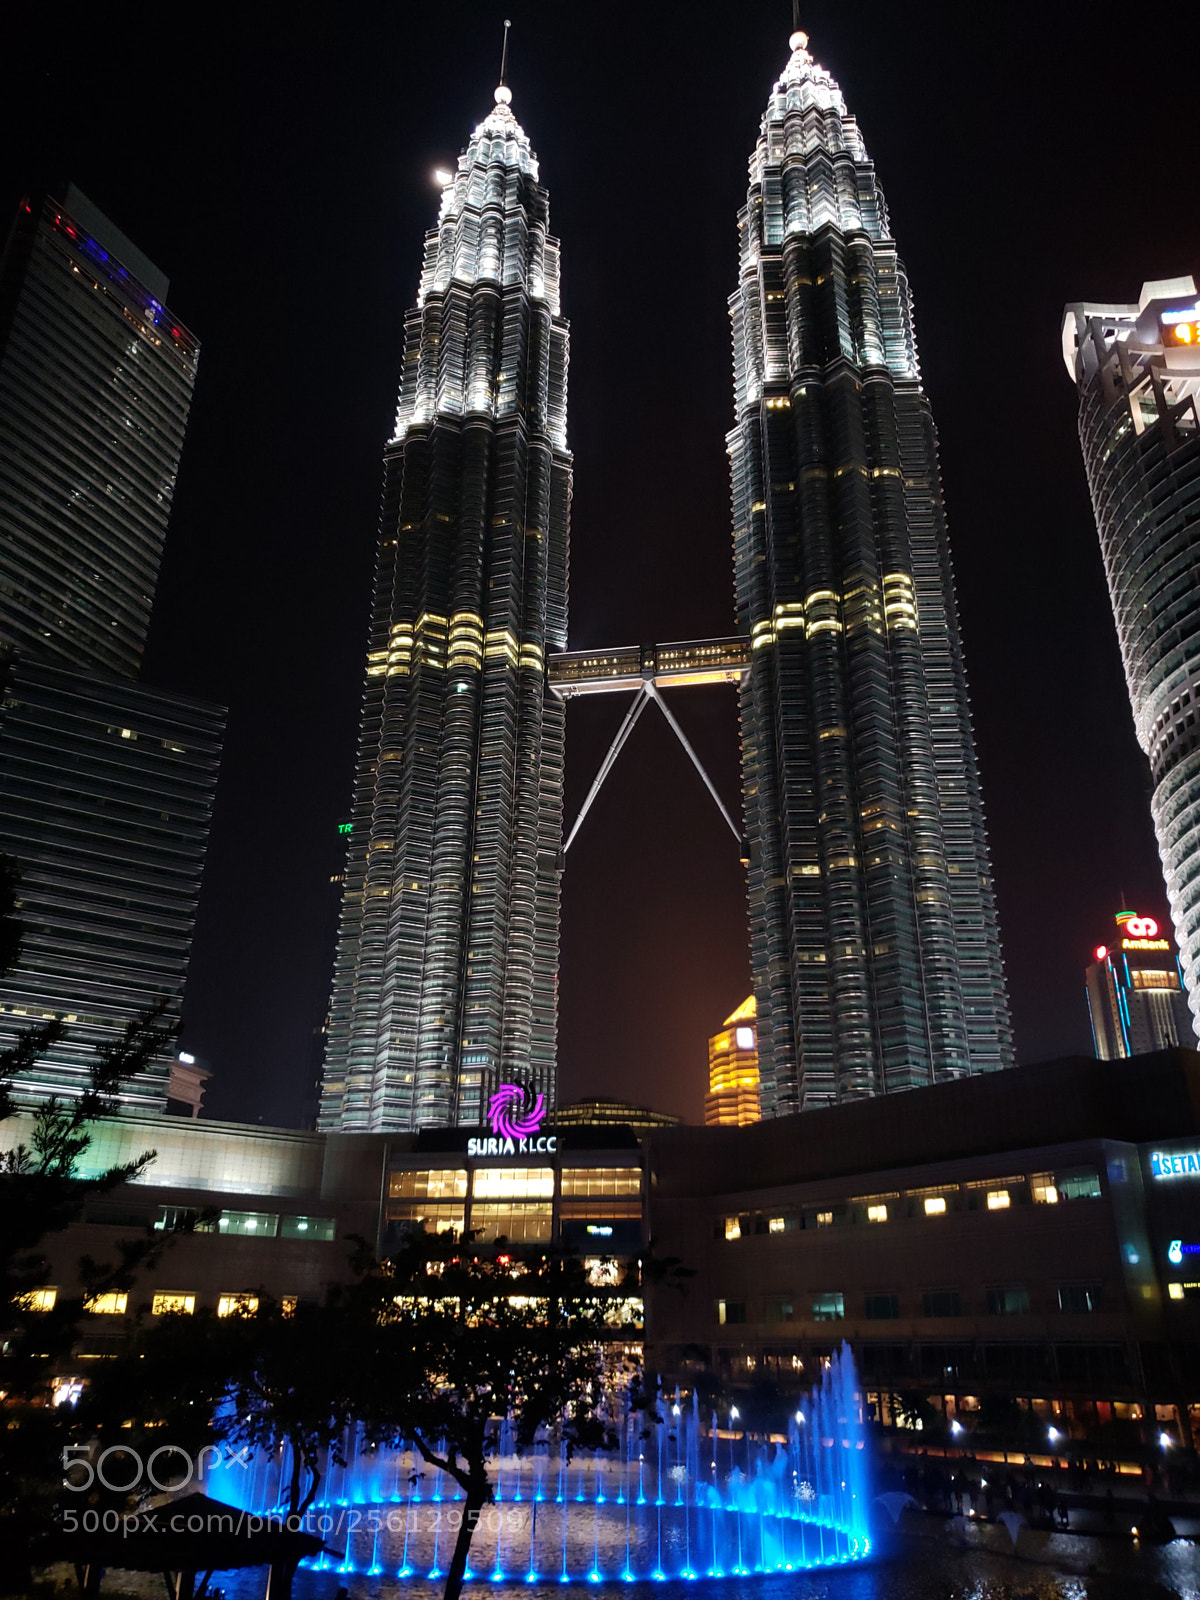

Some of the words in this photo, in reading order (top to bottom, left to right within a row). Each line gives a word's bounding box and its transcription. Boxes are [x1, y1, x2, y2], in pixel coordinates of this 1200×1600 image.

[1122, 938, 1170, 950] AmBank
[467, 1136, 516, 1157] SURIA
[519, 1136, 557, 1154] KLCC
